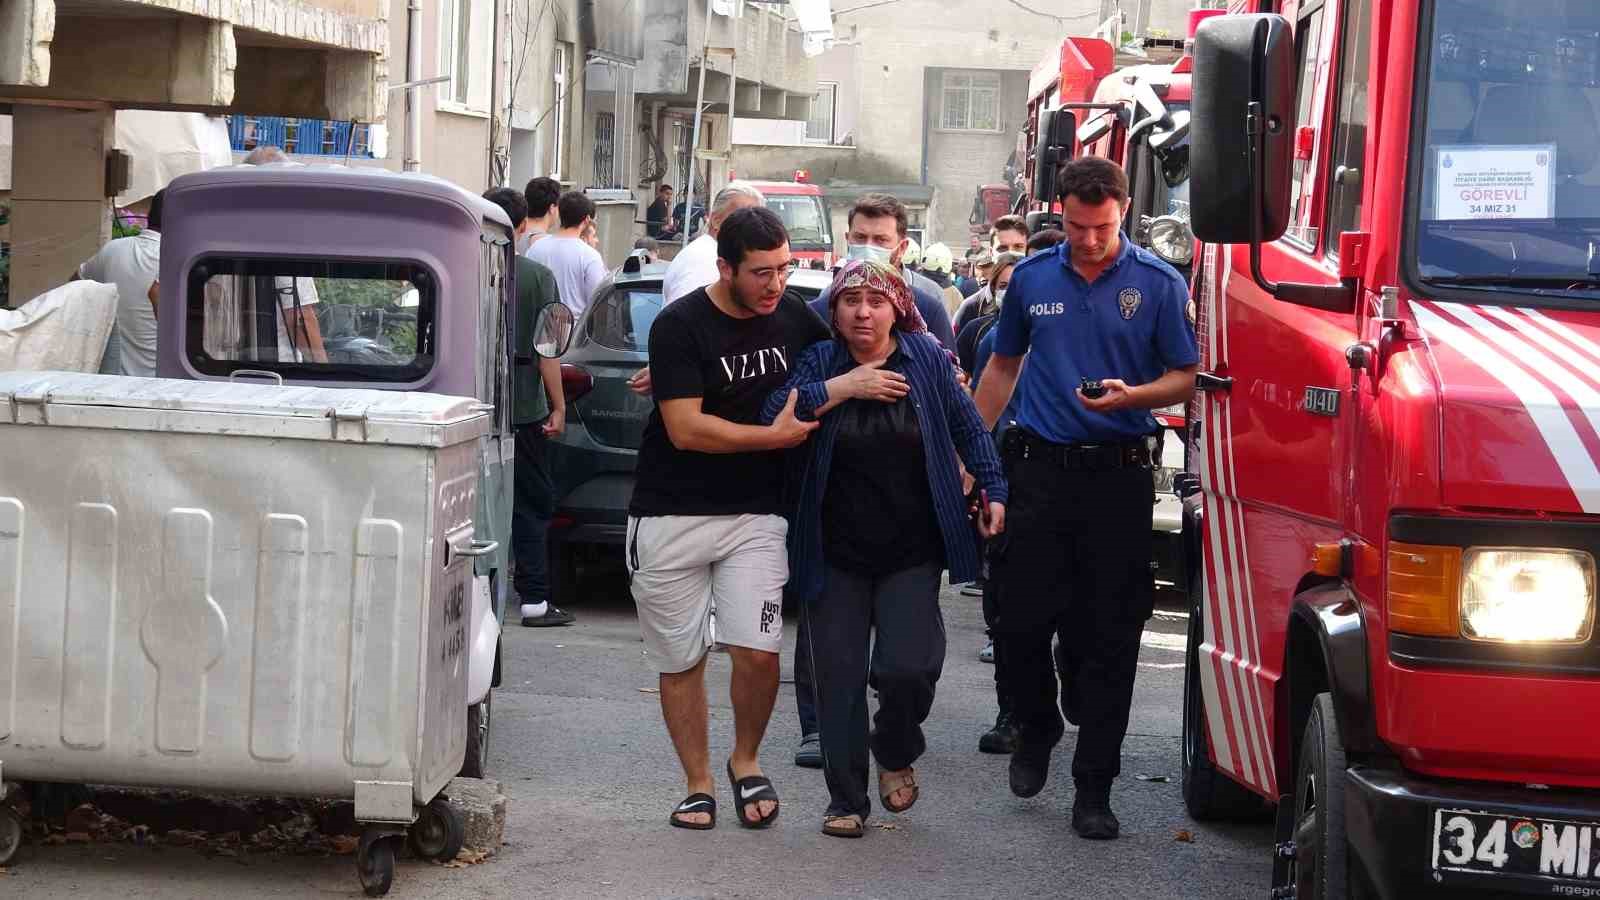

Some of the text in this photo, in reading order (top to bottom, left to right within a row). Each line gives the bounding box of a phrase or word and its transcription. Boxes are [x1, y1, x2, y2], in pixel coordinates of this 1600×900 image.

[1459, 187, 1528, 201] GÖREVLİ
[1469, 204, 1517, 214] 34 MIZ 31
[719, 345, 788, 383] VLTN
[761, 600, 780, 616] JUST
[760, 611, 775, 624] DO
[760, 622, 771, 634] IT.
[1442, 815, 1600, 880] 34 MI
